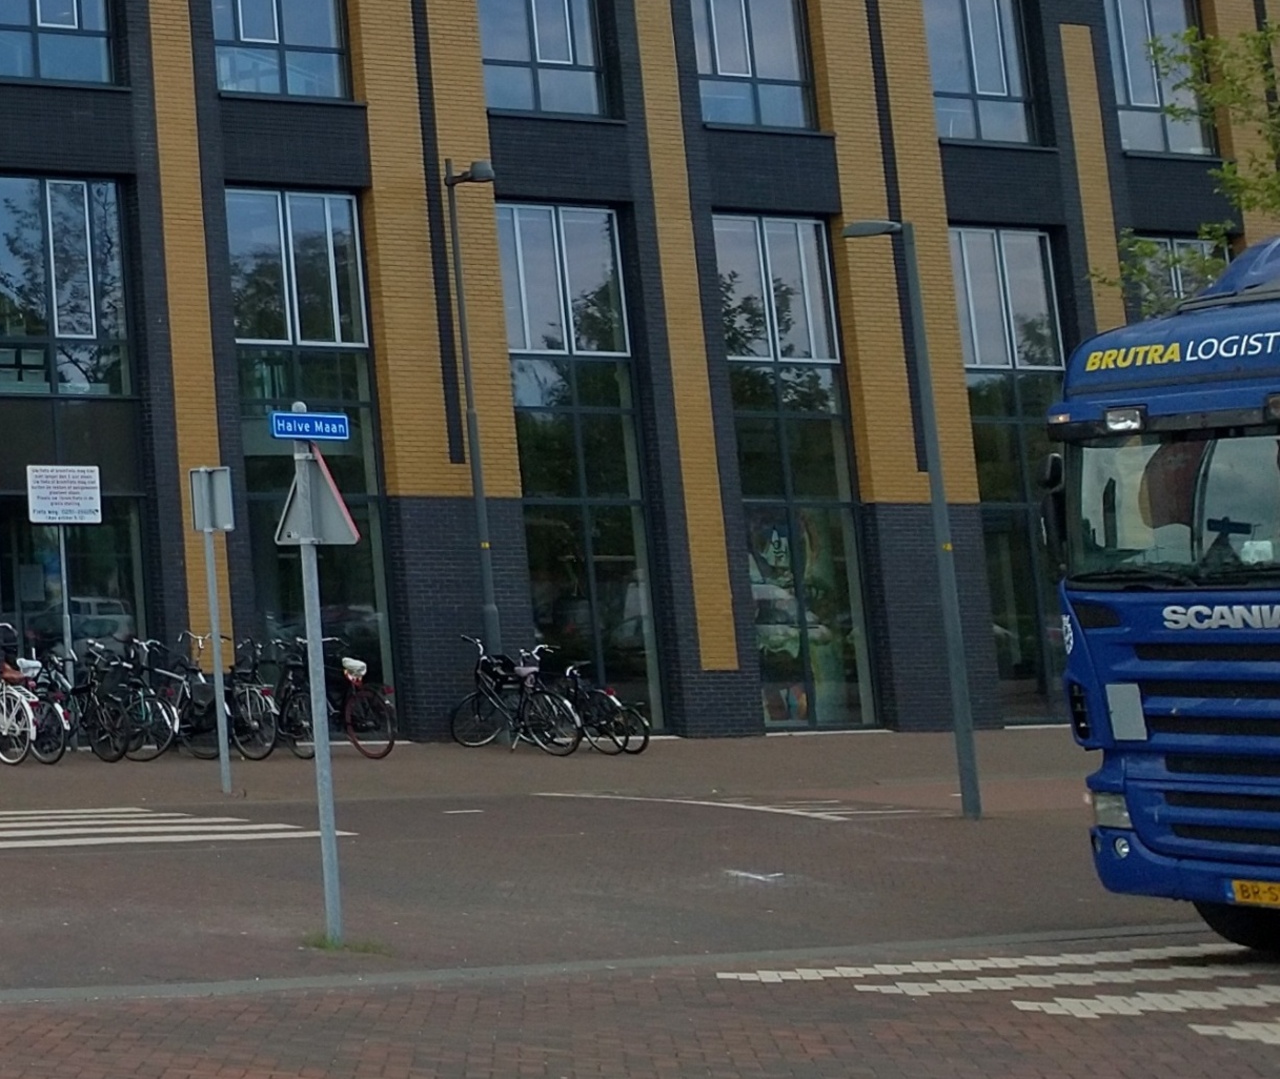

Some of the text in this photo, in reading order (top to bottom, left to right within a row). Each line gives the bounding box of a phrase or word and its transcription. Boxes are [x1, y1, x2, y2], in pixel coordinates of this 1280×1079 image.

[1085, 342, 1181, 371] BRUTRA
[277, 418, 345, 434] Halve Maan
[1162, 605, 1280, 629] SCANI
